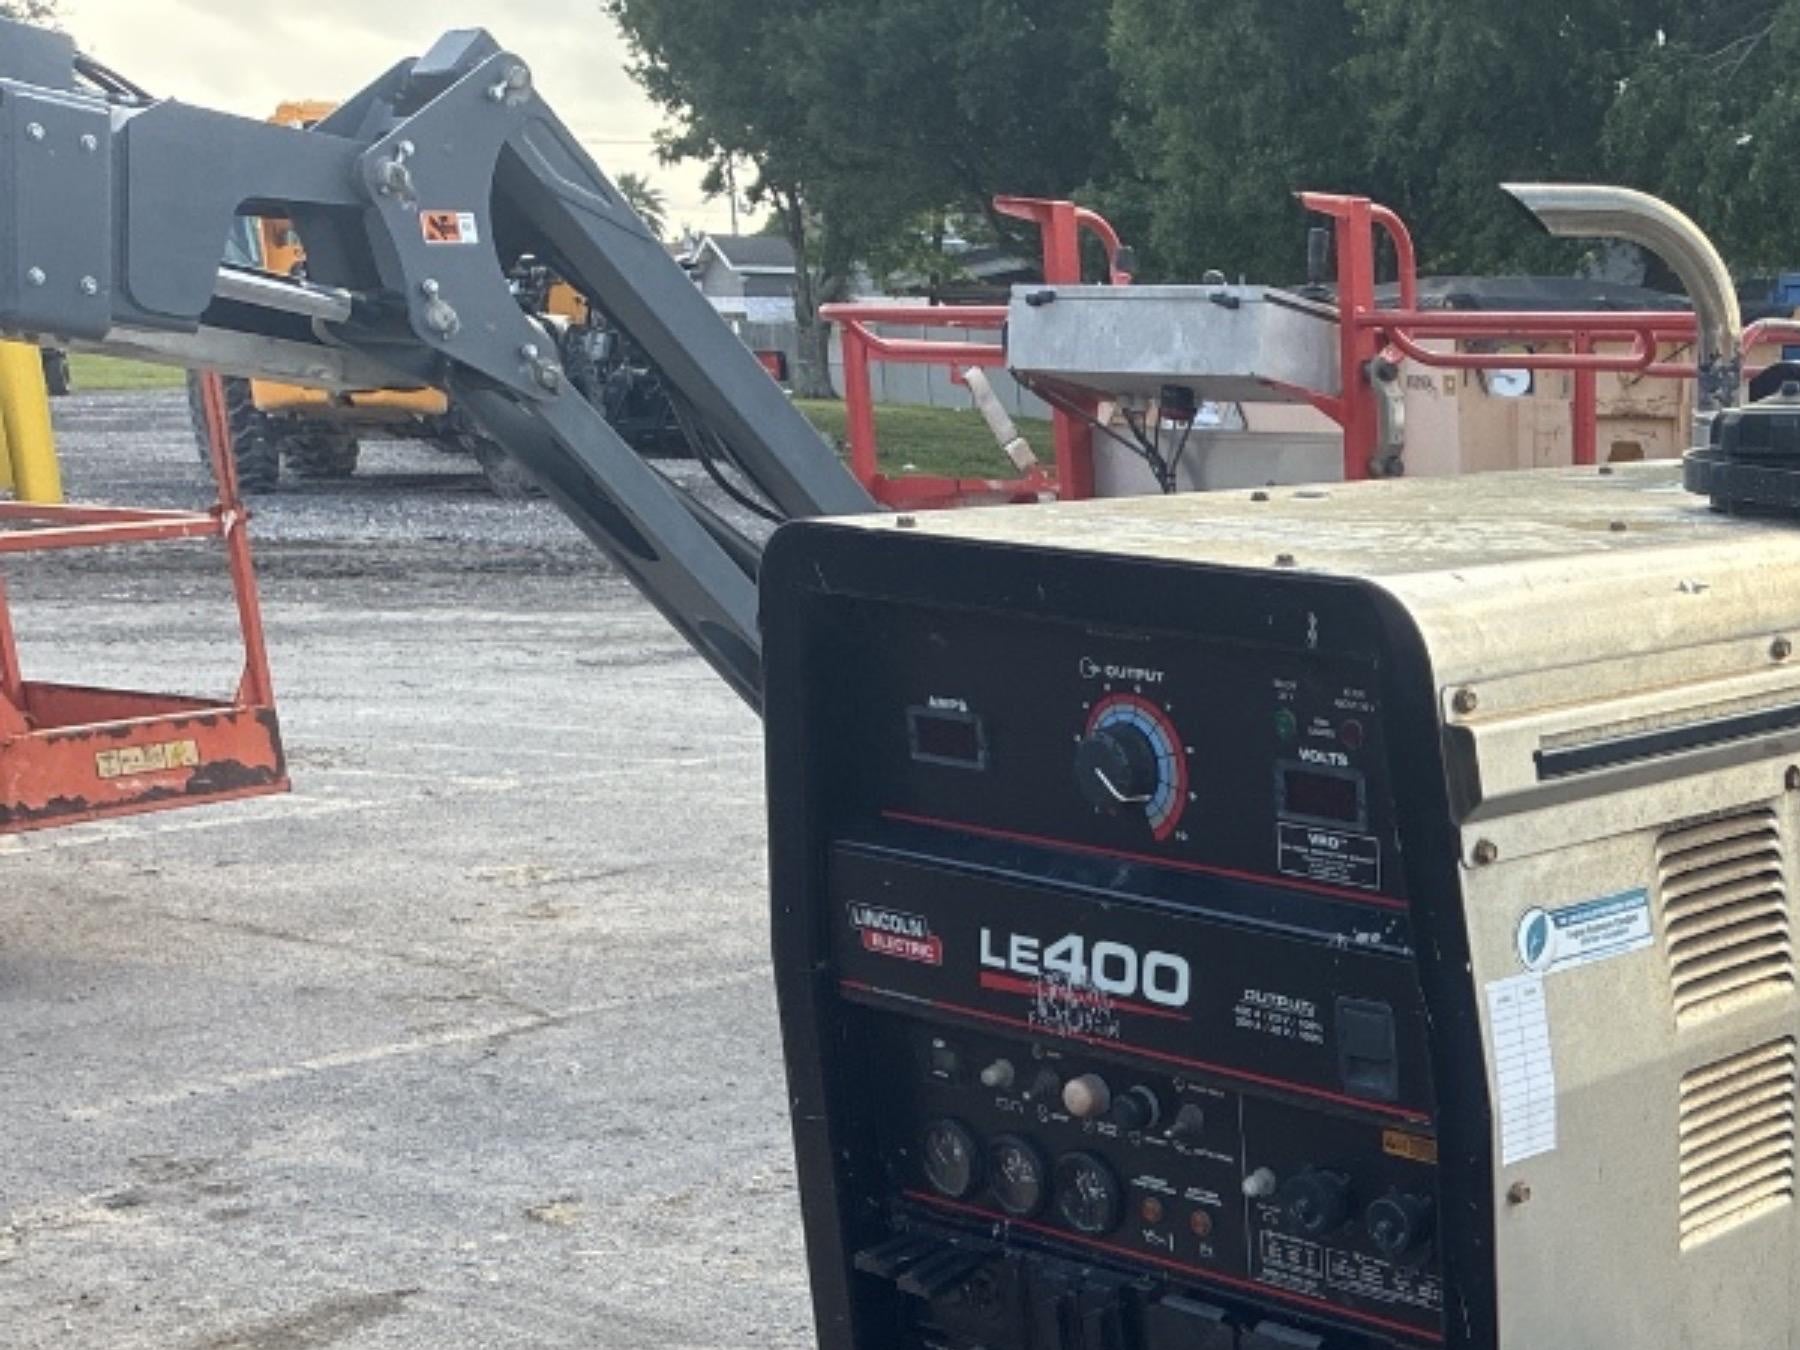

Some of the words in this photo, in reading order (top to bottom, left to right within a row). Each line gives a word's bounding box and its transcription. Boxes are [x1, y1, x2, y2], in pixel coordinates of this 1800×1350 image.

[1103, 664, 1165, 683] OUTPUT
[851, 904, 924, 938] LINCOLN
[871, 931, 937, 959] ELECTRIC
[979, 926, 1191, 1008] LE400
